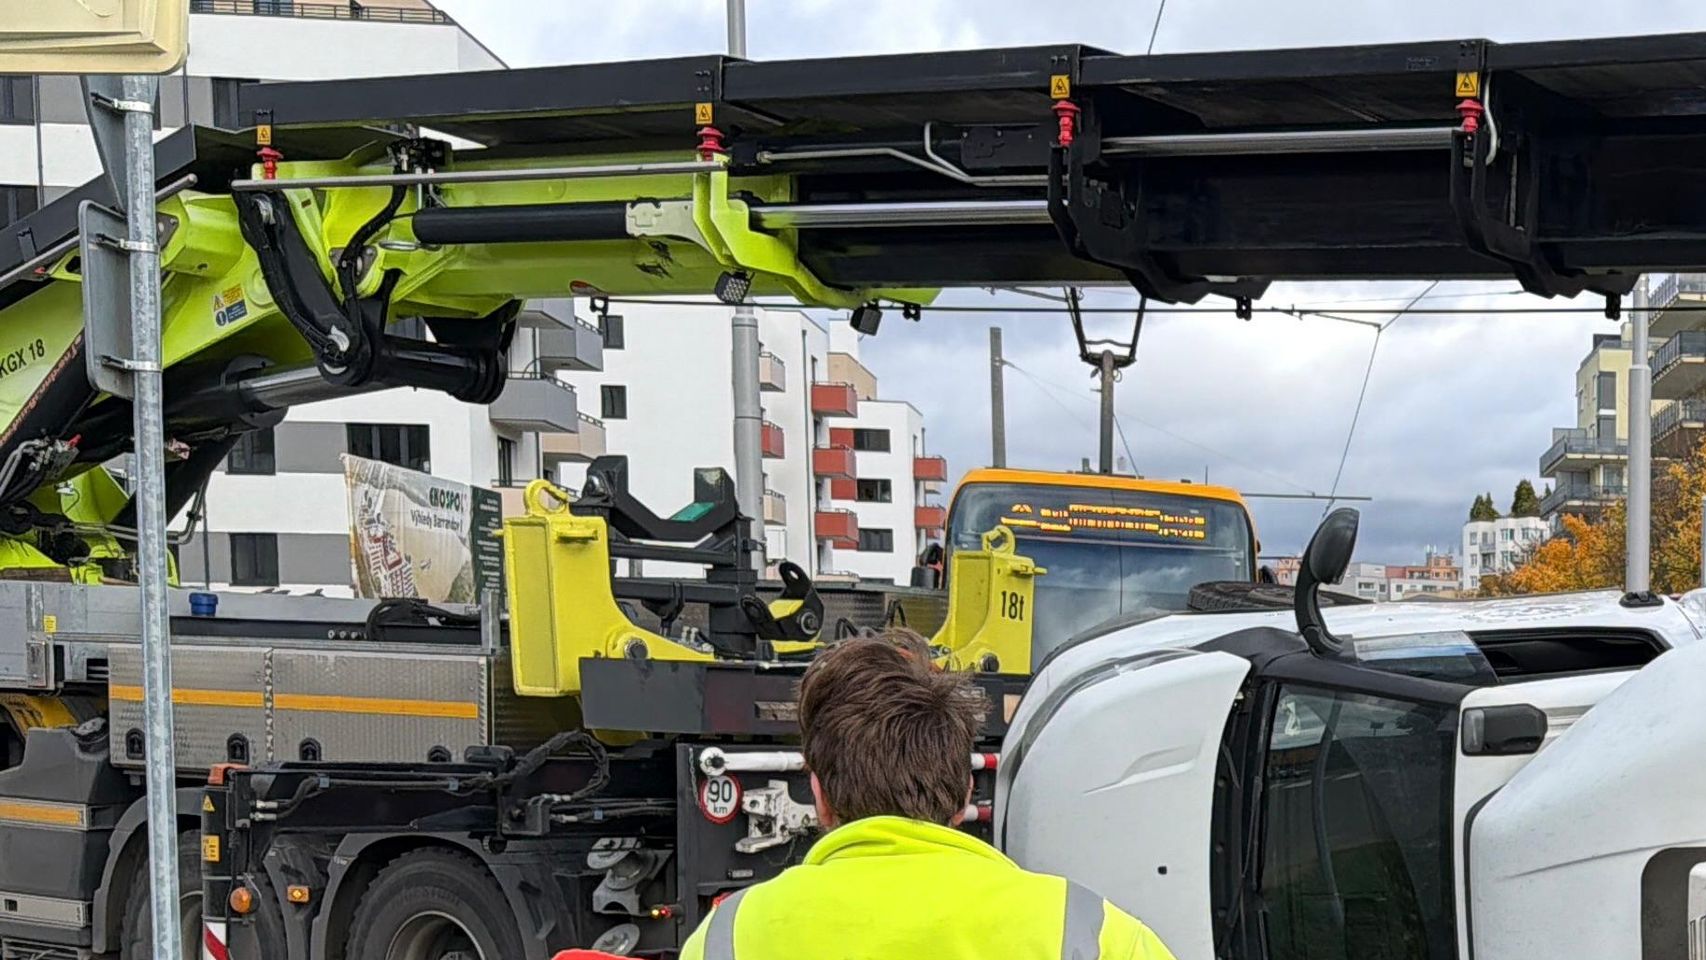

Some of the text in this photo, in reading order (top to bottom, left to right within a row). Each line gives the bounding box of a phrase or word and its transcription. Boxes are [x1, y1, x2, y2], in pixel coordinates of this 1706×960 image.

[28, 338, 46, 361] 18
[1001, 590, 1025, 621] 18t
[709, 780, 732, 803] 90
[713, 804, 728, 814] km
